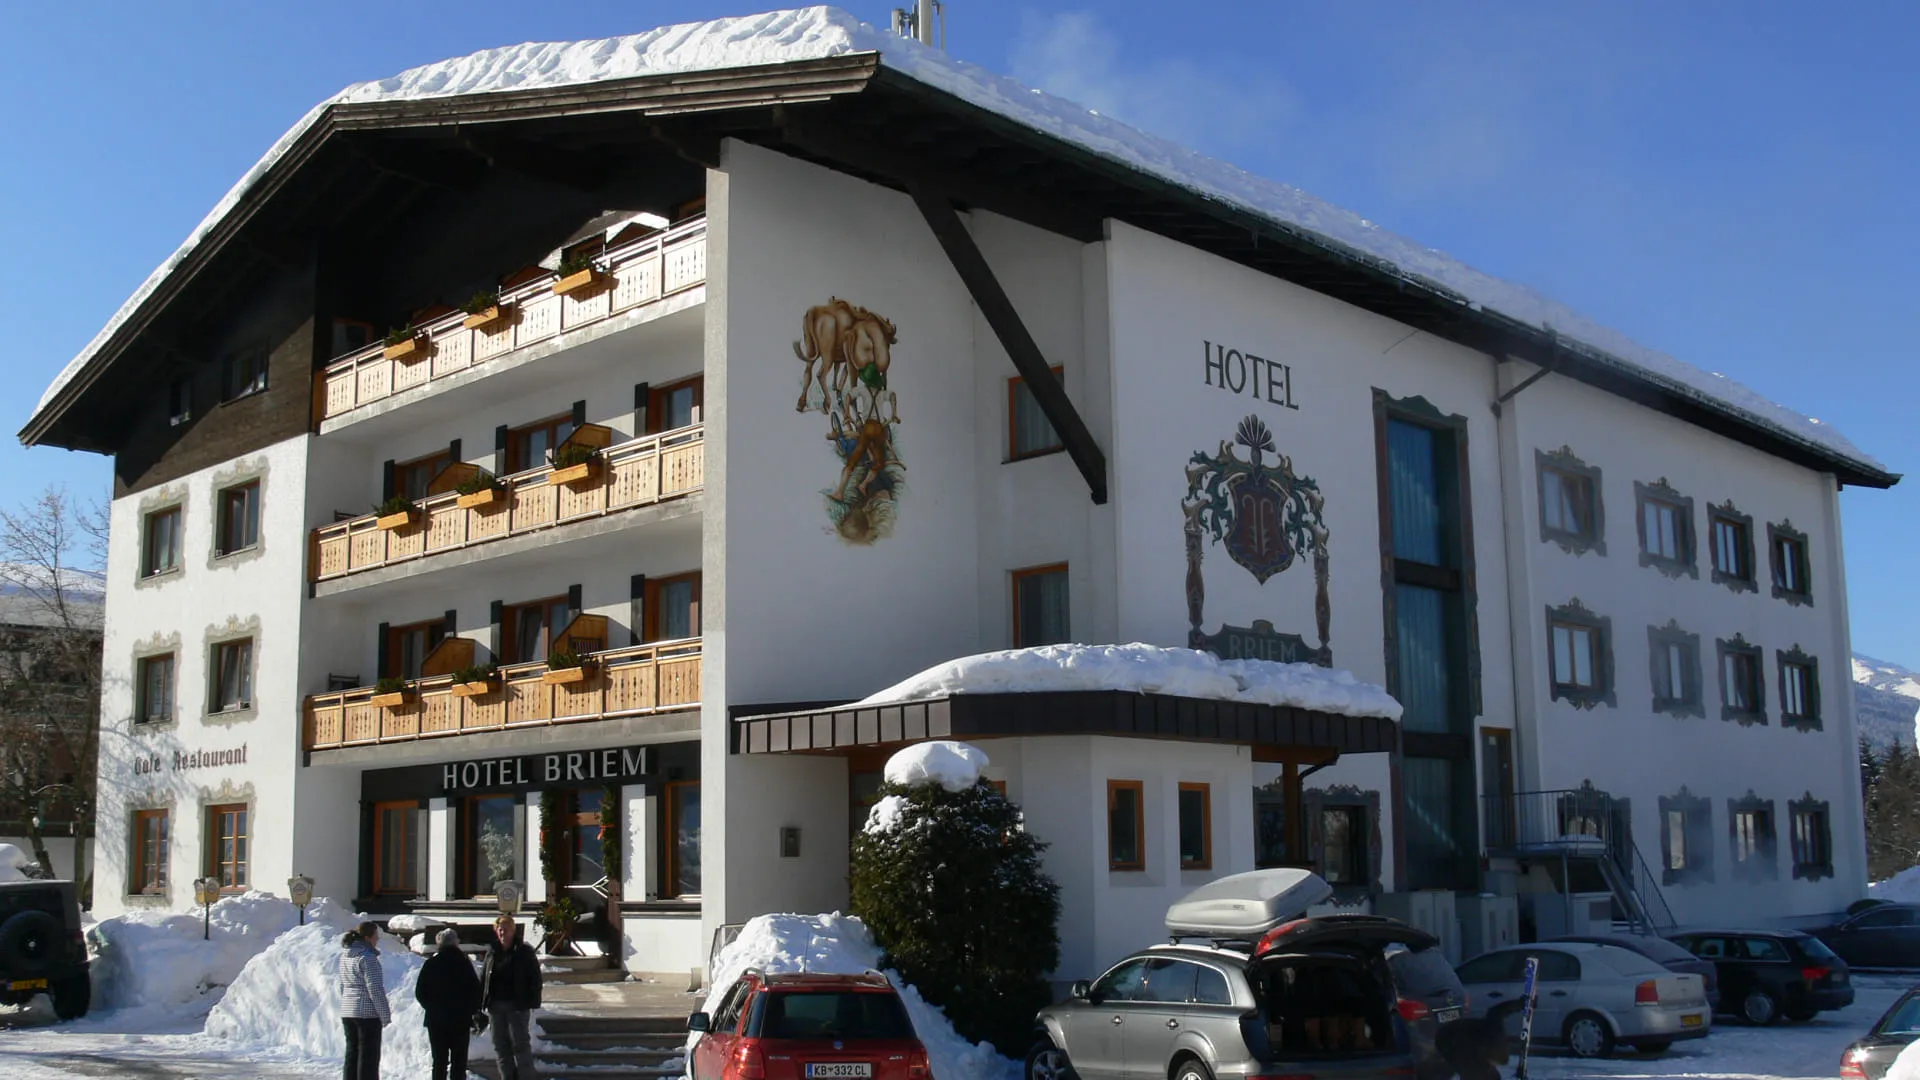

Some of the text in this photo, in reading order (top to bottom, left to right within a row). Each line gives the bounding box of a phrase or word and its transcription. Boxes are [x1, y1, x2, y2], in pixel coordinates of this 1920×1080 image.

[1203, 340, 1299, 411] HOTEL
[1229, 634, 1297, 662] BRIEM
[172, 741, 248, 772] Restaurant
[443, 747, 647, 790] HOTEL BRIEM
[814, 1065, 867, 1076] KB 332 CL
